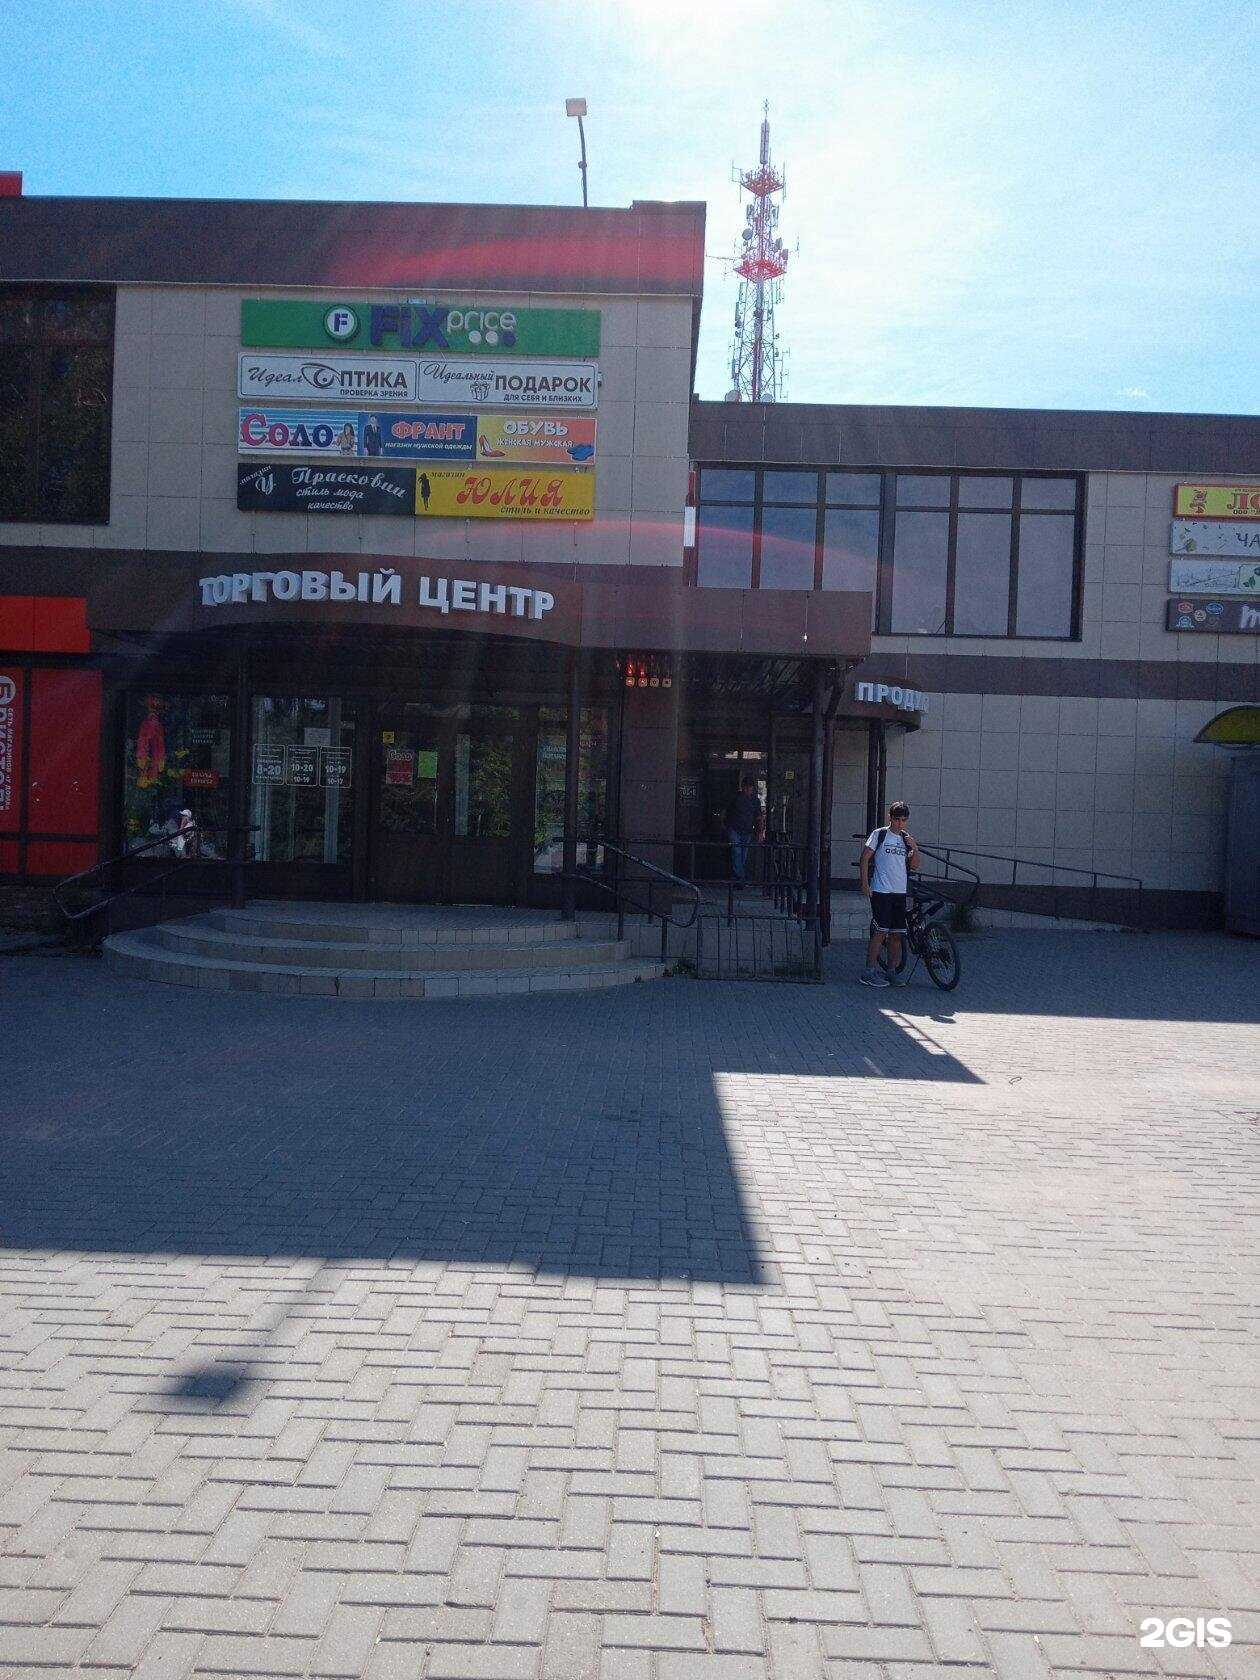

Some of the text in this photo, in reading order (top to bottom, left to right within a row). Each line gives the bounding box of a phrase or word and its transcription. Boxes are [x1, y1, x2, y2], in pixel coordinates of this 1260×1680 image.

[370, 305, 517, 348] FIX price
[424, 364, 495, 383] Идеальный
[495, 375, 592, 393] ПОДАРОК
[340, 389, 379, 397] ПРОВЕРКА
[391, 420, 466, 440] ФРАНТ
[503, 420, 569, 436] ОБУВЬ
[296, 486, 367, 500] стиль мода
[307, 501, 354, 511] качество
[500, 506, 532, 515] стиль
[543, 507, 590, 516] качество
[199, 567, 555, 620] ТОРГОВЫЙ ЦЕНТР
